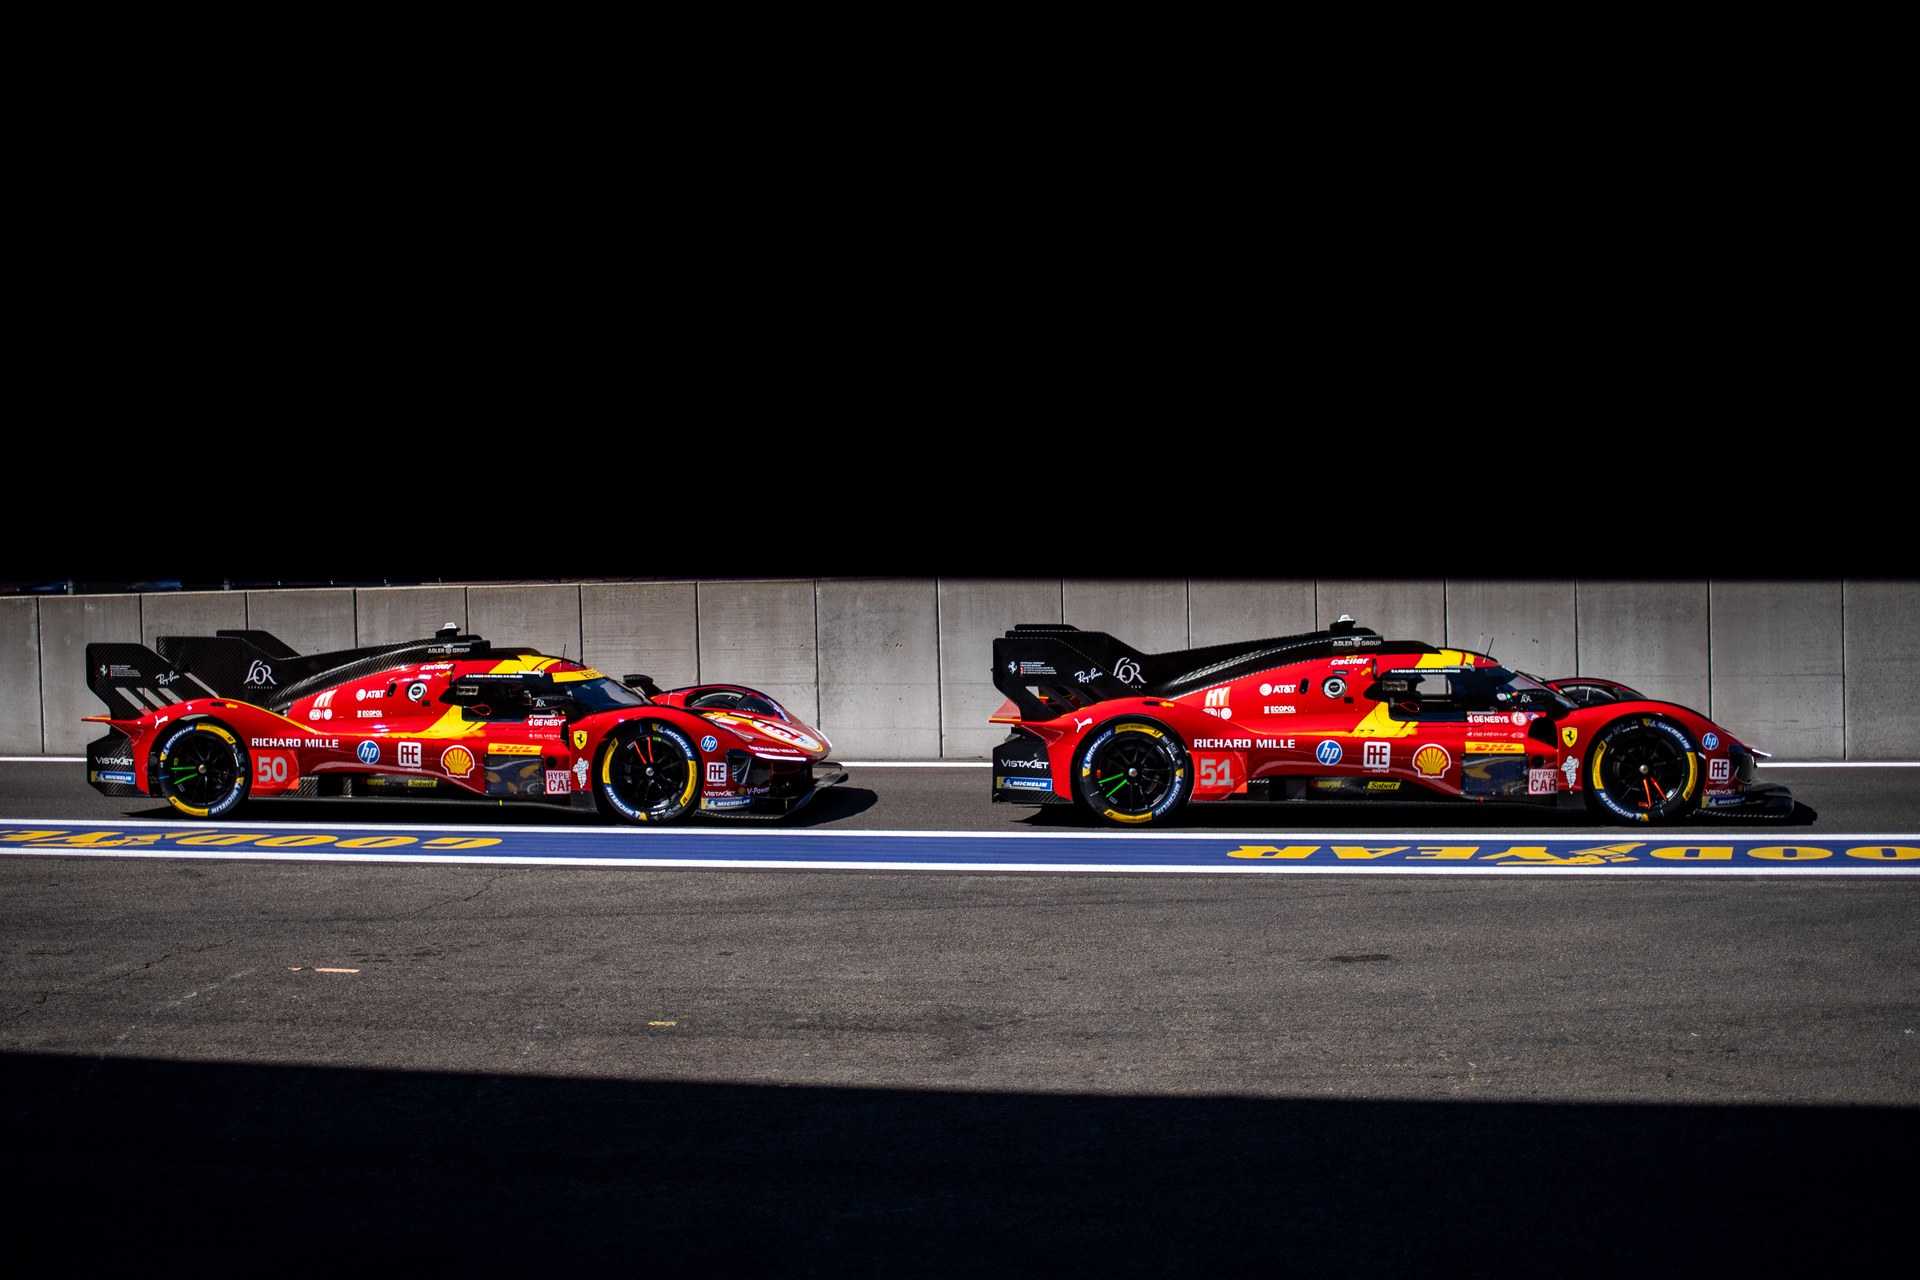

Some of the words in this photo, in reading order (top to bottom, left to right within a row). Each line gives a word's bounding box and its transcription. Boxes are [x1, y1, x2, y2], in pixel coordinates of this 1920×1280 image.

[1074, 667, 1103, 684] Ray-Ban
[366, 689, 385, 699] AT&T
[1272, 684, 1297, 694] AT&T
[533, 718, 566, 727] GENESY
[1473, 715, 1510, 724] GENESYS
[251, 738, 301, 748] RICHARD
[304, 738, 339, 748] MILLE
[663, 727, 693, 758] MICHELIN
[702, 735, 716, 752] hp
[1193, 738, 1252, 749] RICHARD
[1256, 739, 1296, 749] MILLE
[1704, 733, 1718, 750] hp
[495, 745, 533, 753] DHL
[1474, 743, 1516, 751] DHL
[360, 740, 378, 765] hp
[1319, 740, 1340, 766] hp
[257, 756, 288, 783] 50
[1200, 758, 1234, 786] 51
[1530, 771, 1558, 779] HYPER
[1012, 780, 1048, 788] MICHELIN
[1530, 779, 1558, 792] CAR
[717, 798, 751, 807] MICHELIN
